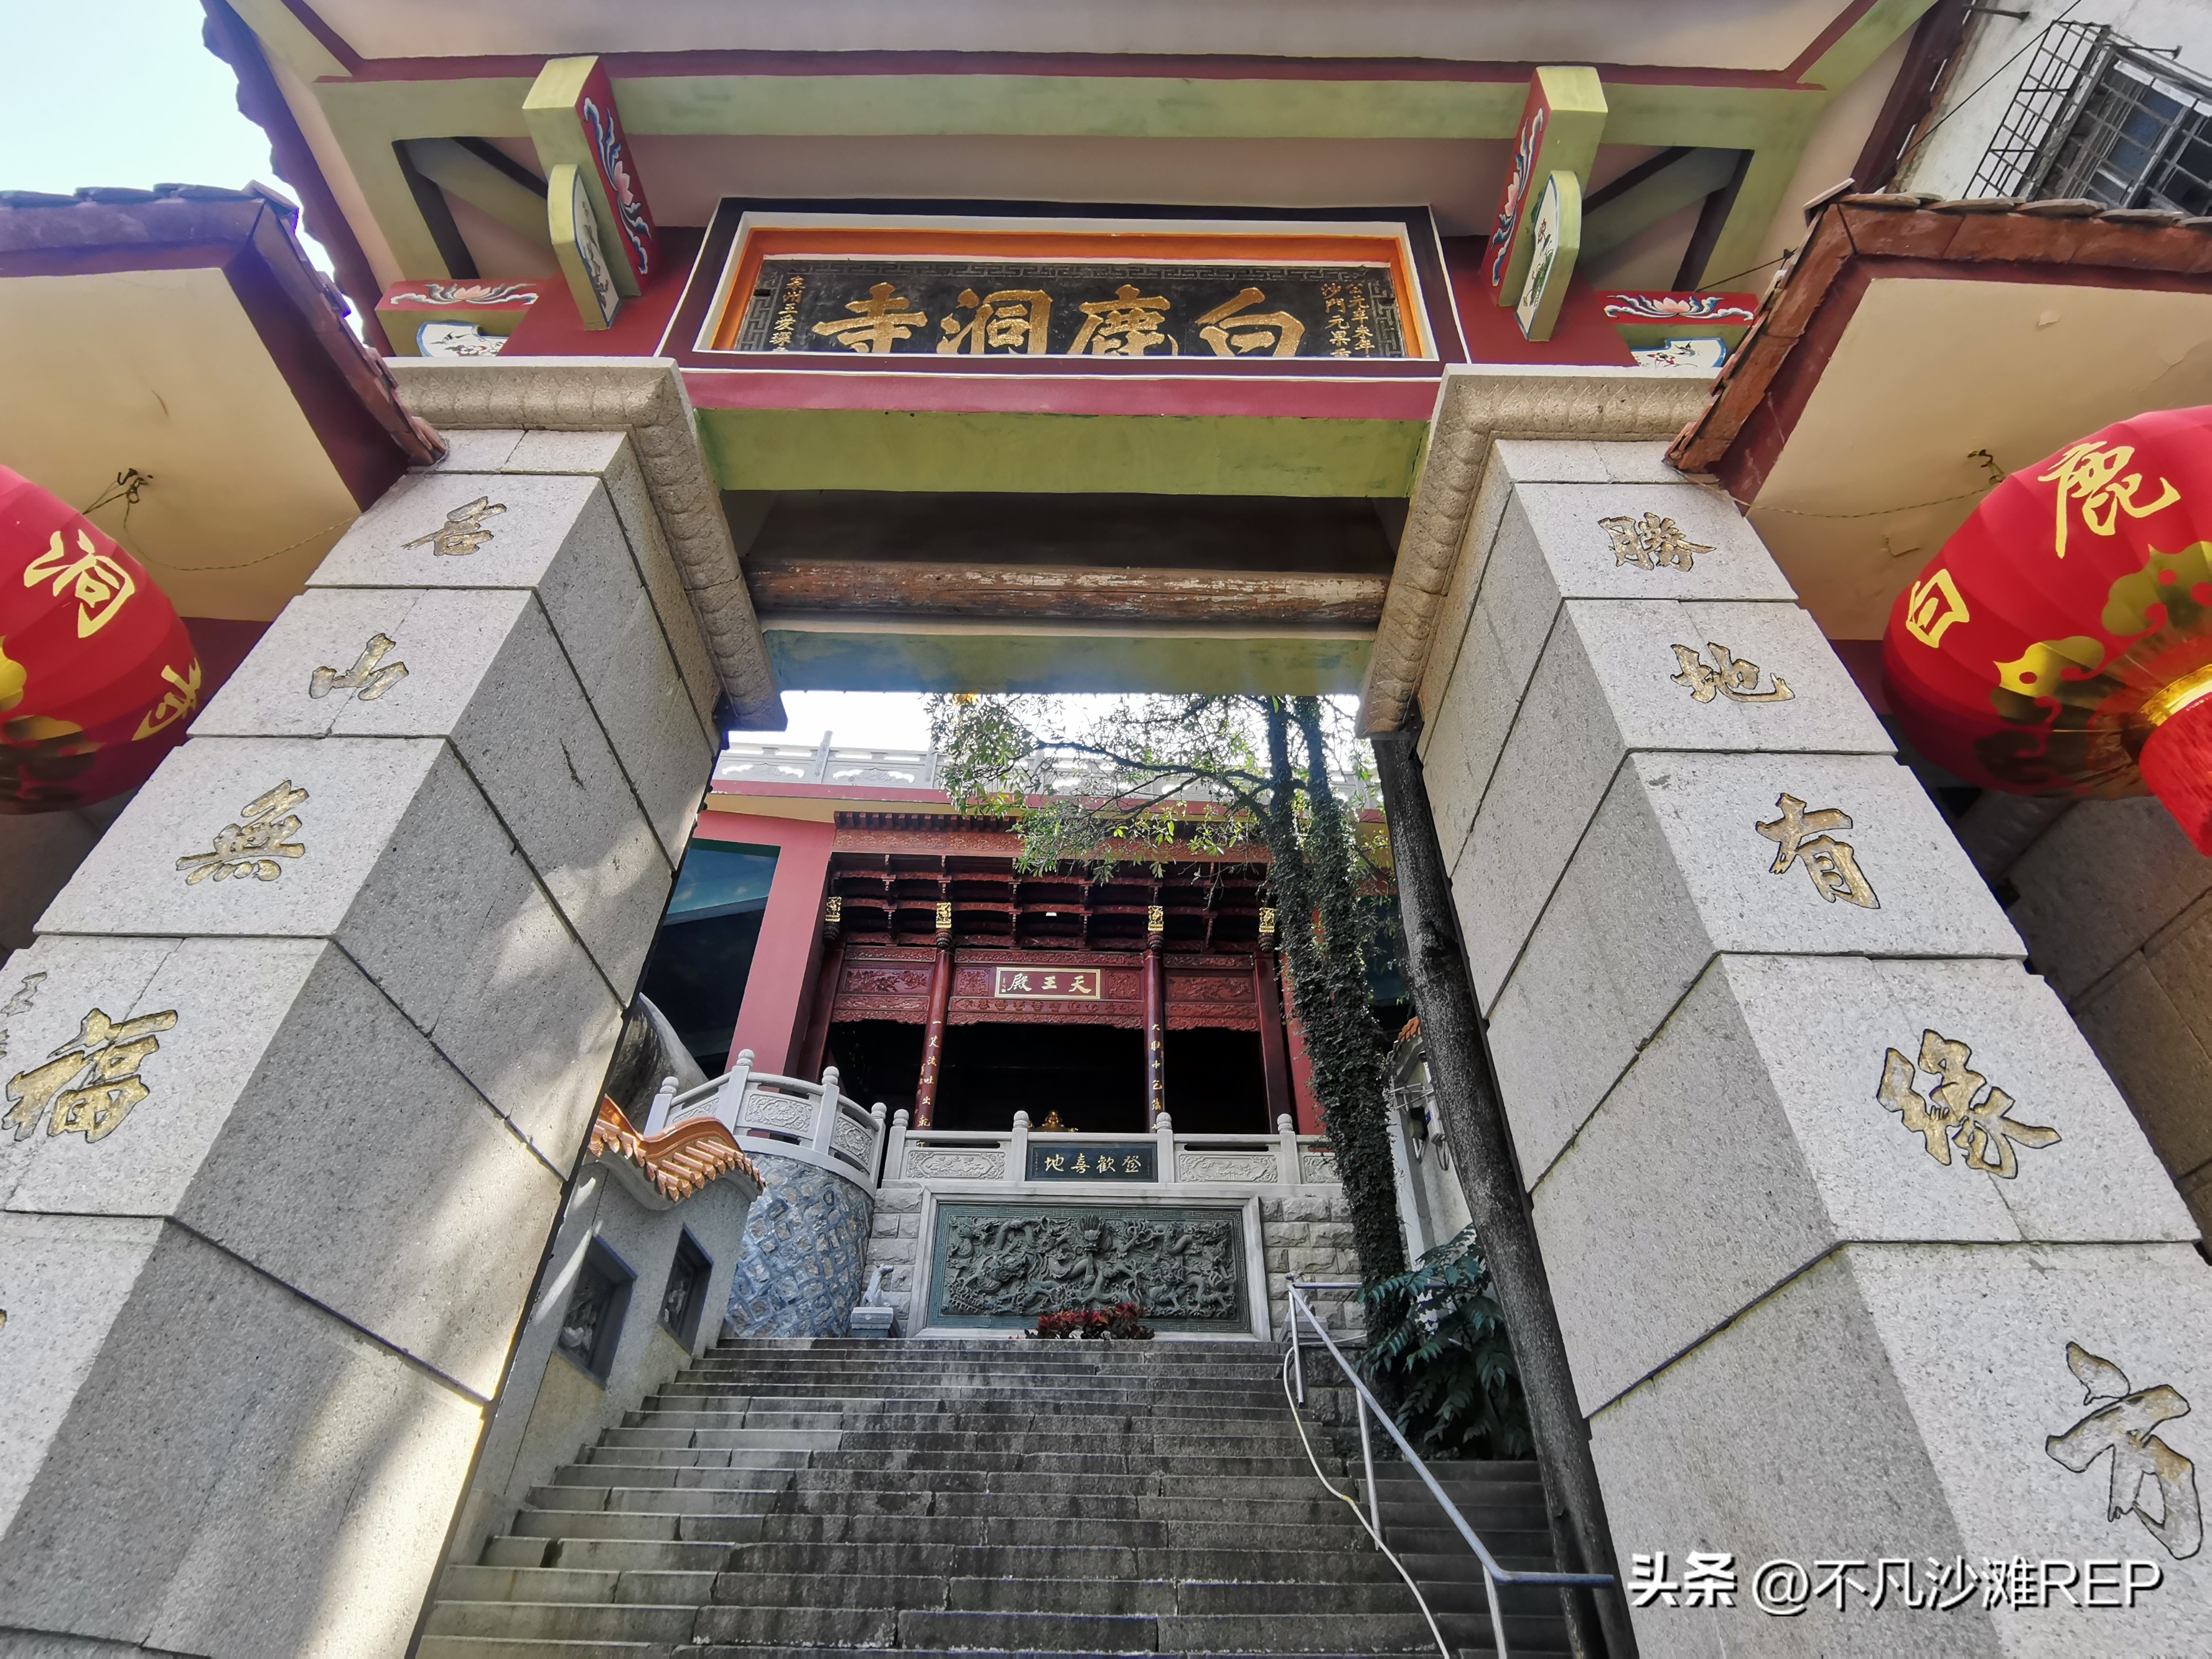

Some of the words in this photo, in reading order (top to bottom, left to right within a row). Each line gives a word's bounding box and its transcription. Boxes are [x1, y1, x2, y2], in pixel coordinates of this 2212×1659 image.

[1007, 973, 1092, 994] 天王殿
[1044, 1153, 1142, 1174] 登歡喜地
